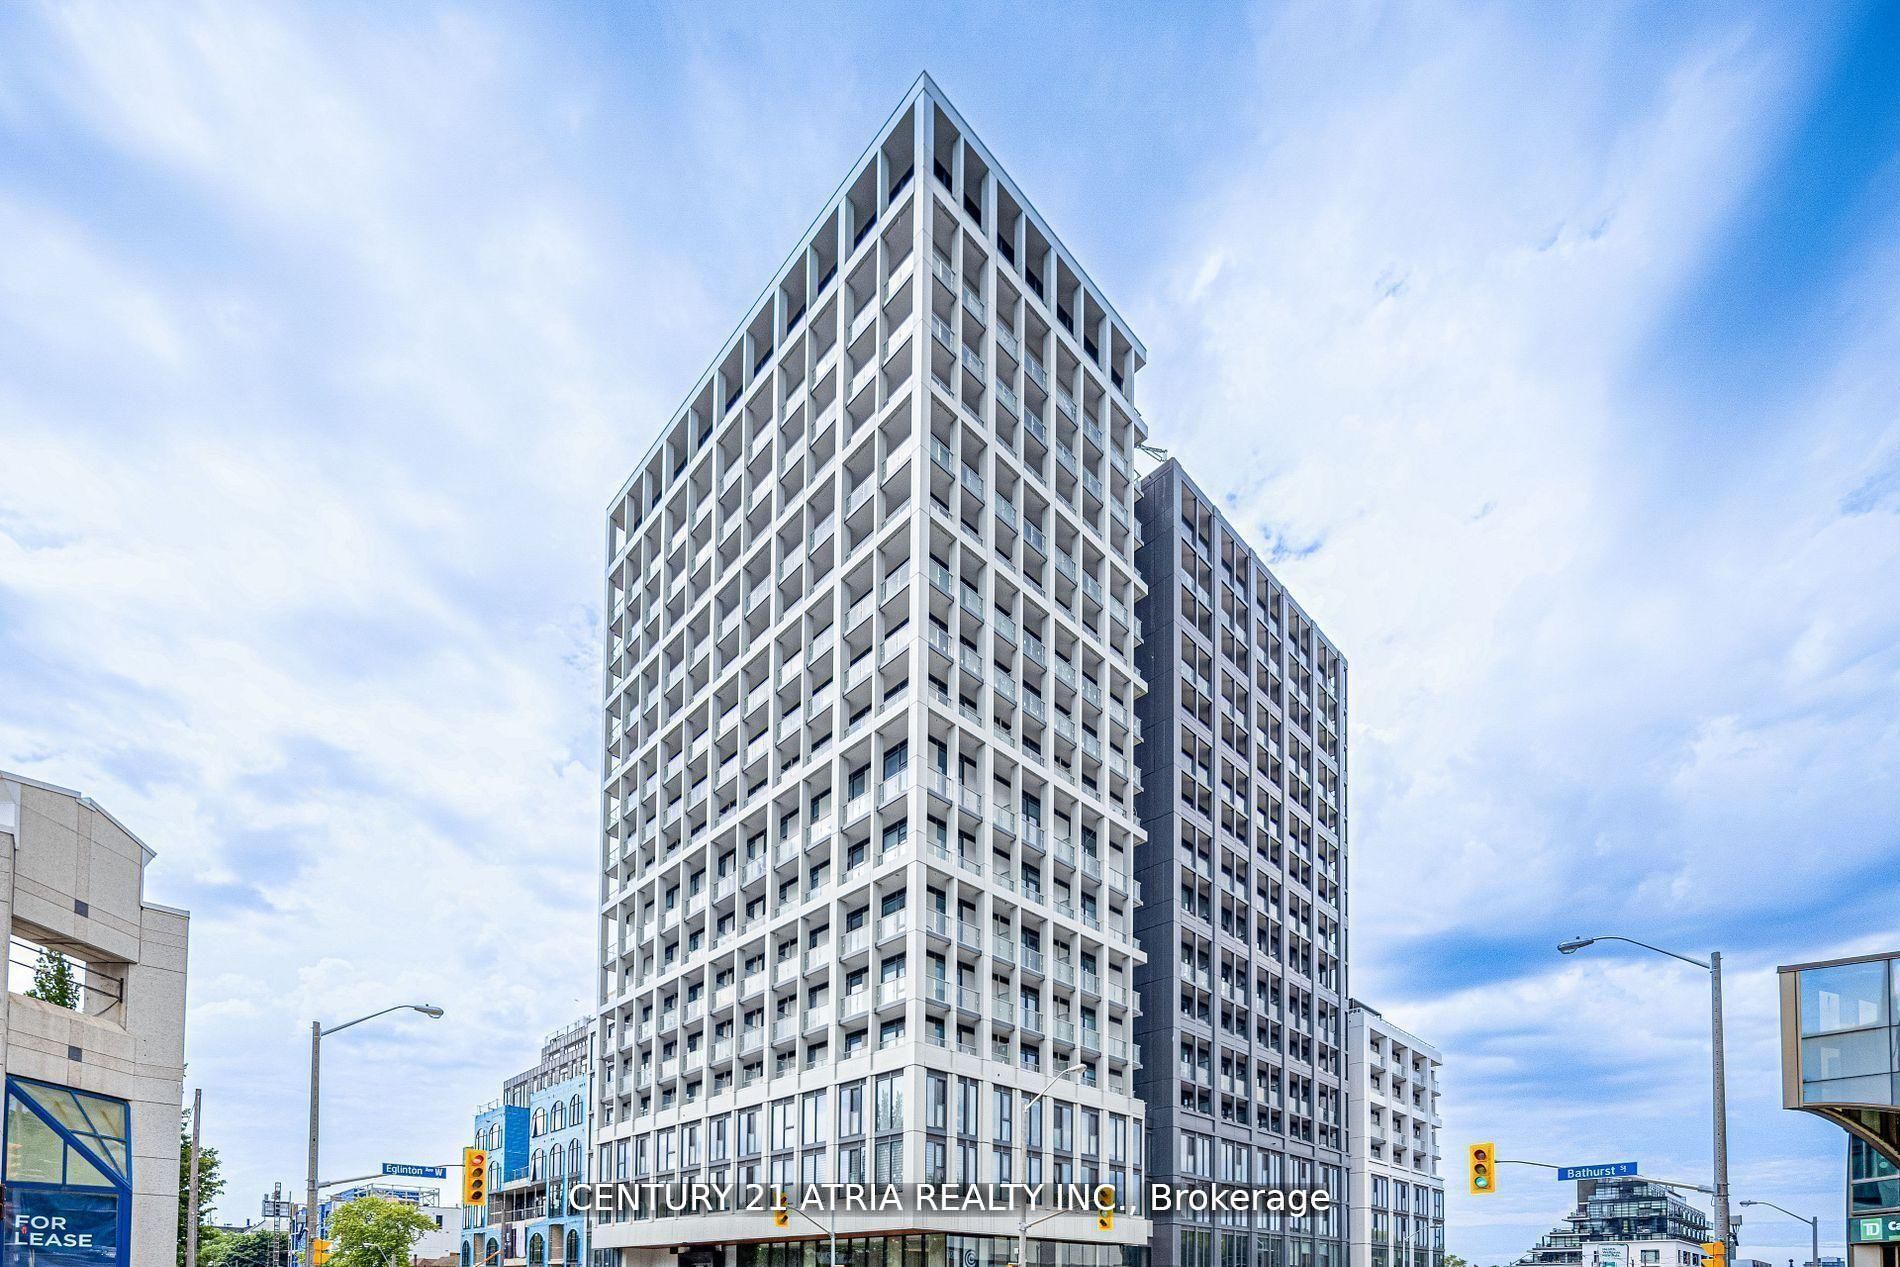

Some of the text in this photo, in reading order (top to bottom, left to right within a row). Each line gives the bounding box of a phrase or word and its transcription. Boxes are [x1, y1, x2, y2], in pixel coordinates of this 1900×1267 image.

[386, 1164, 423, 1175] Eglinton
[435, 1168, 443, 1176] W
[1567, 1166, 1616, 1178] Bathurst
[14, 1215, 67, 1230] FOR
[1862, 1222, 1880, 1236] TD
[14, 1231, 93, 1248] LEASE
